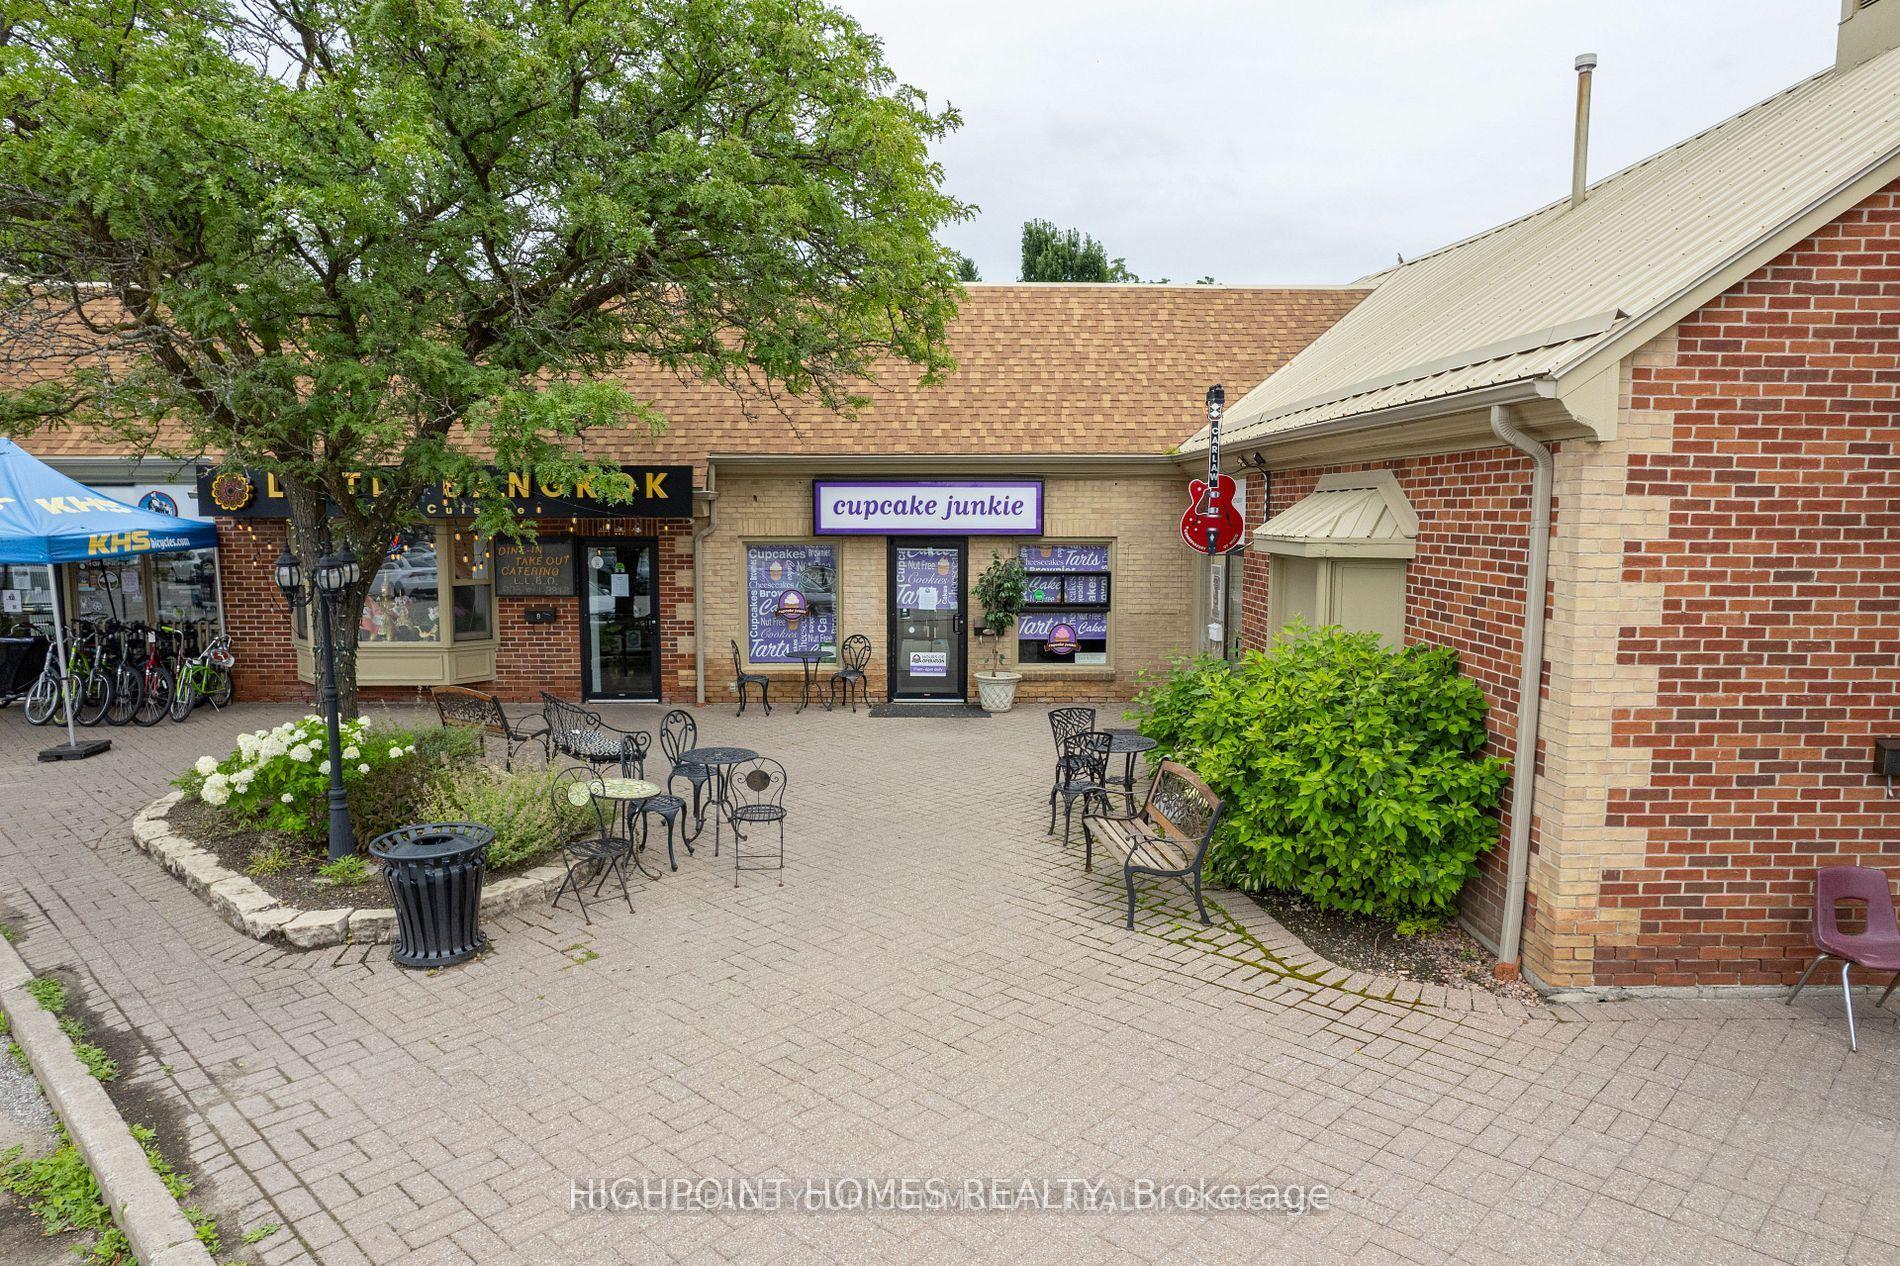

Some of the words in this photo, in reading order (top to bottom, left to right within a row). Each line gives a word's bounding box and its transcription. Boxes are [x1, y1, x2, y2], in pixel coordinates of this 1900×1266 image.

[1209, 427, 1219, 481] CARLAW
[34, 496, 132, 515] KHS
[833, 495, 937, 520] cupcake
[941, 495, 1024, 521] junkie
[88, 531, 151, 555] KHS
[514, 555, 543, 565] TAKE
[546, 554, 570, 565] OUT
[749, 548, 806, 560] Cupcakes
[1065, 550, 1101, 566] Tarts
[501, 565, 560, 576] CATERING
[908, 572, 948, 584] Cookies
[749, 590, 758, 638] Cupcakes
